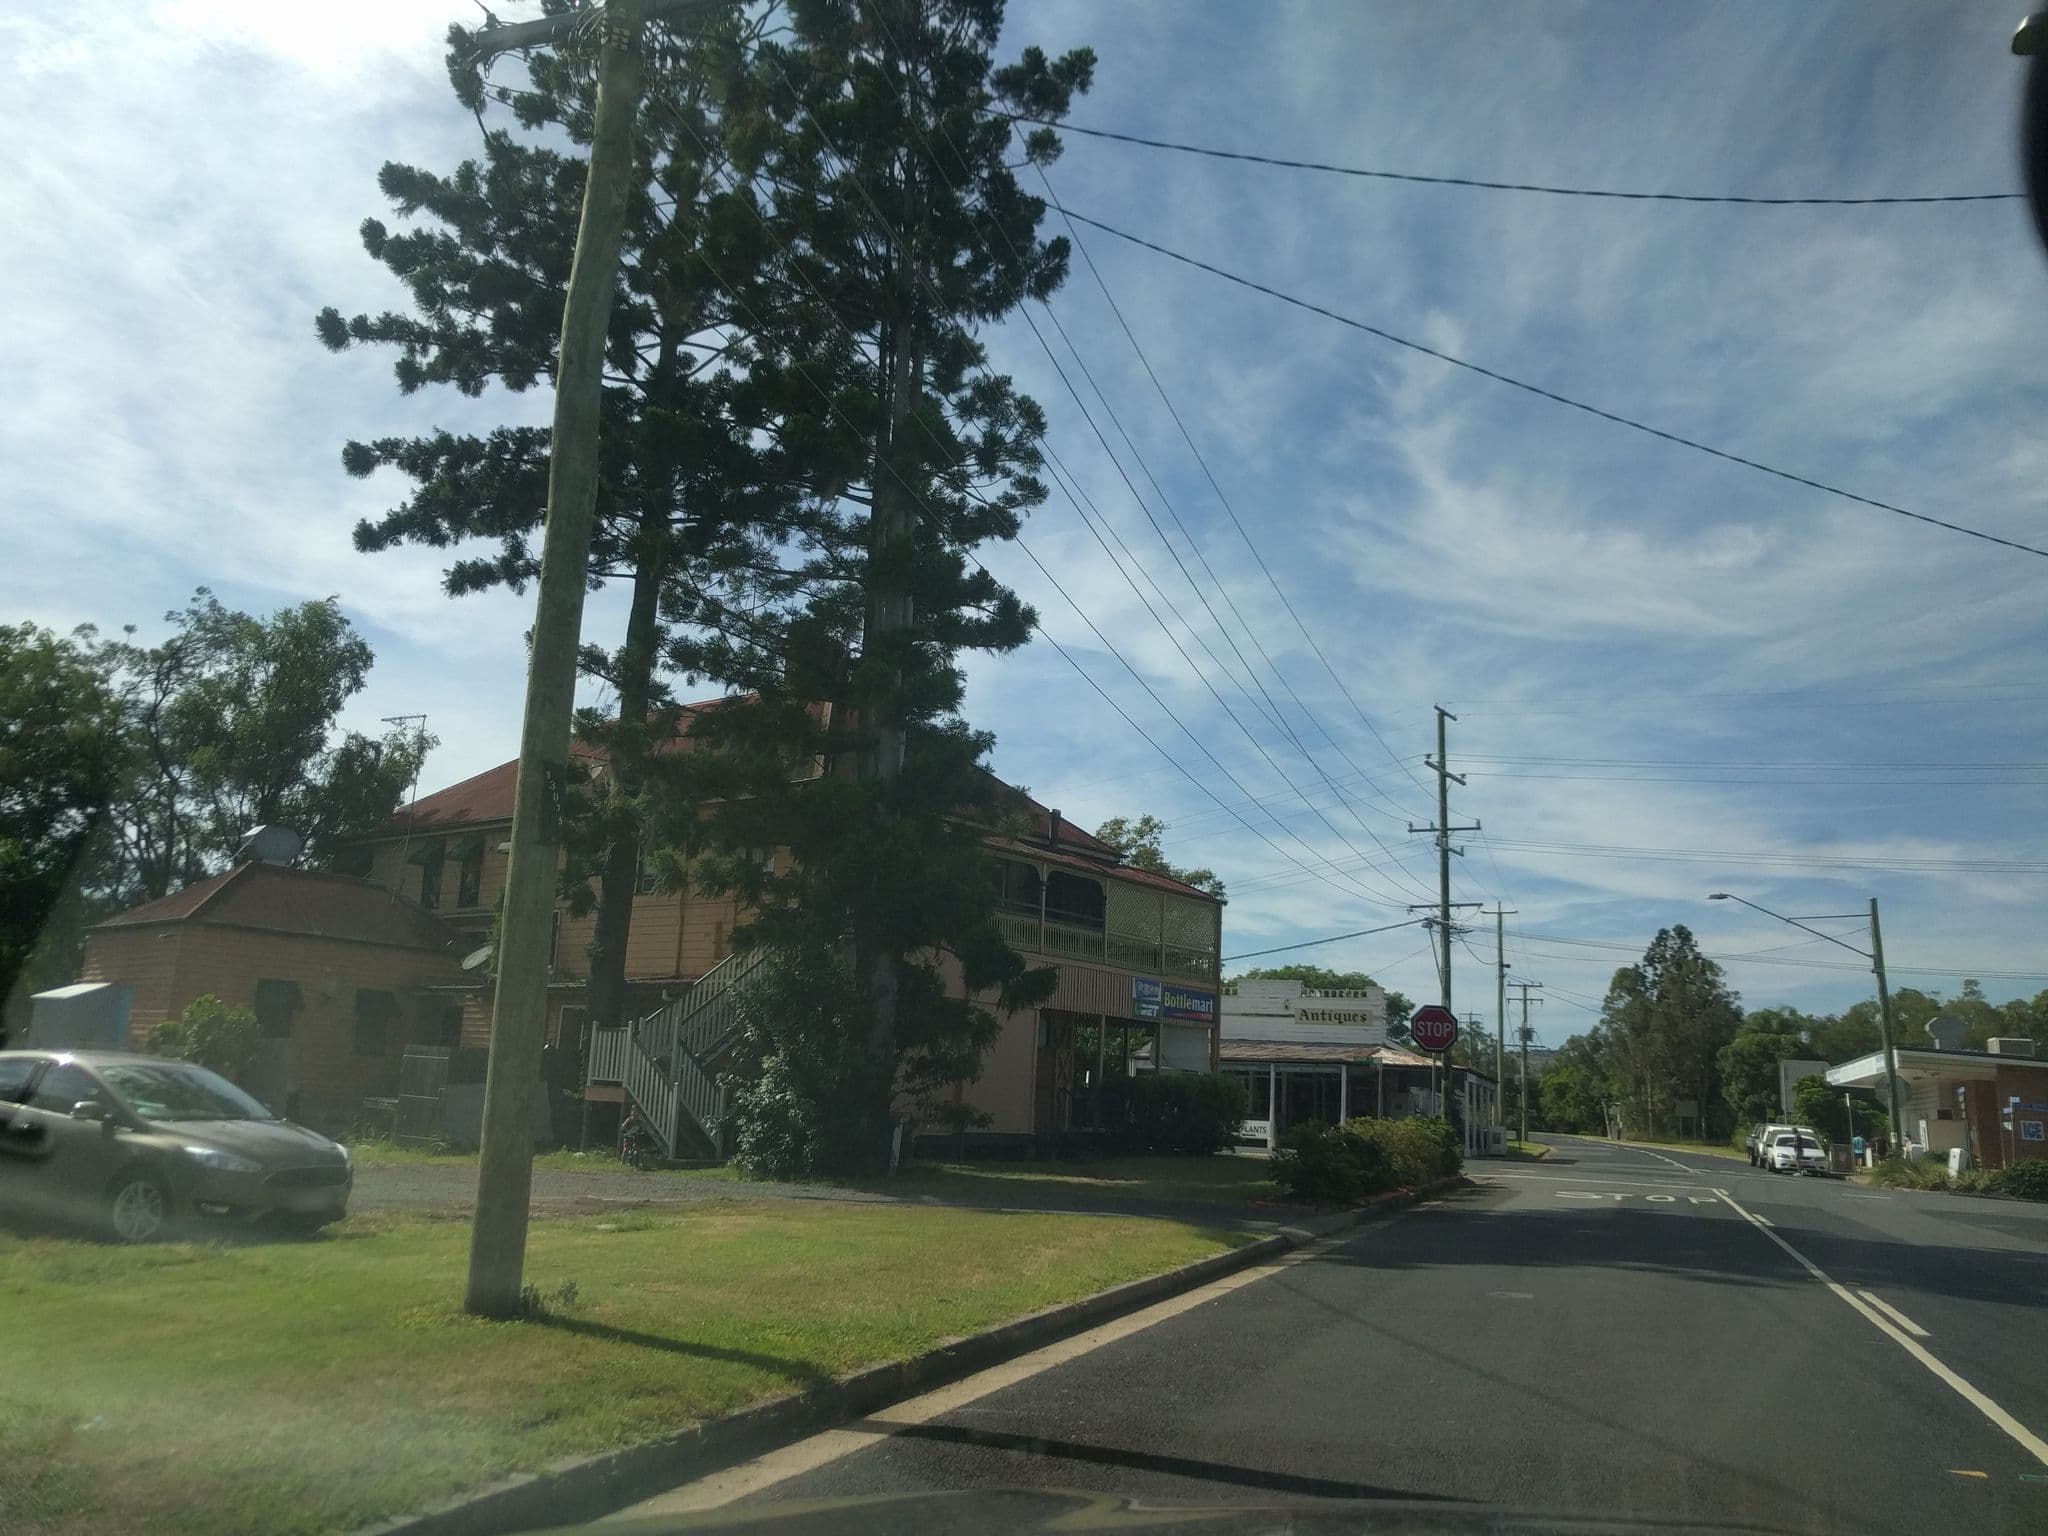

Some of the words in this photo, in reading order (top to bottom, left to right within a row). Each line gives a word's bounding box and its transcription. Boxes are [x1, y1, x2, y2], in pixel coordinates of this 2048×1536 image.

[1164, 992, 1214, 1013] Bottlemart
[1298, 1009, 1368, 1024] Antiques
[1417, 1021, 1453, 1037] STOP
[1554, 1191, 1718, 1204] STOP
